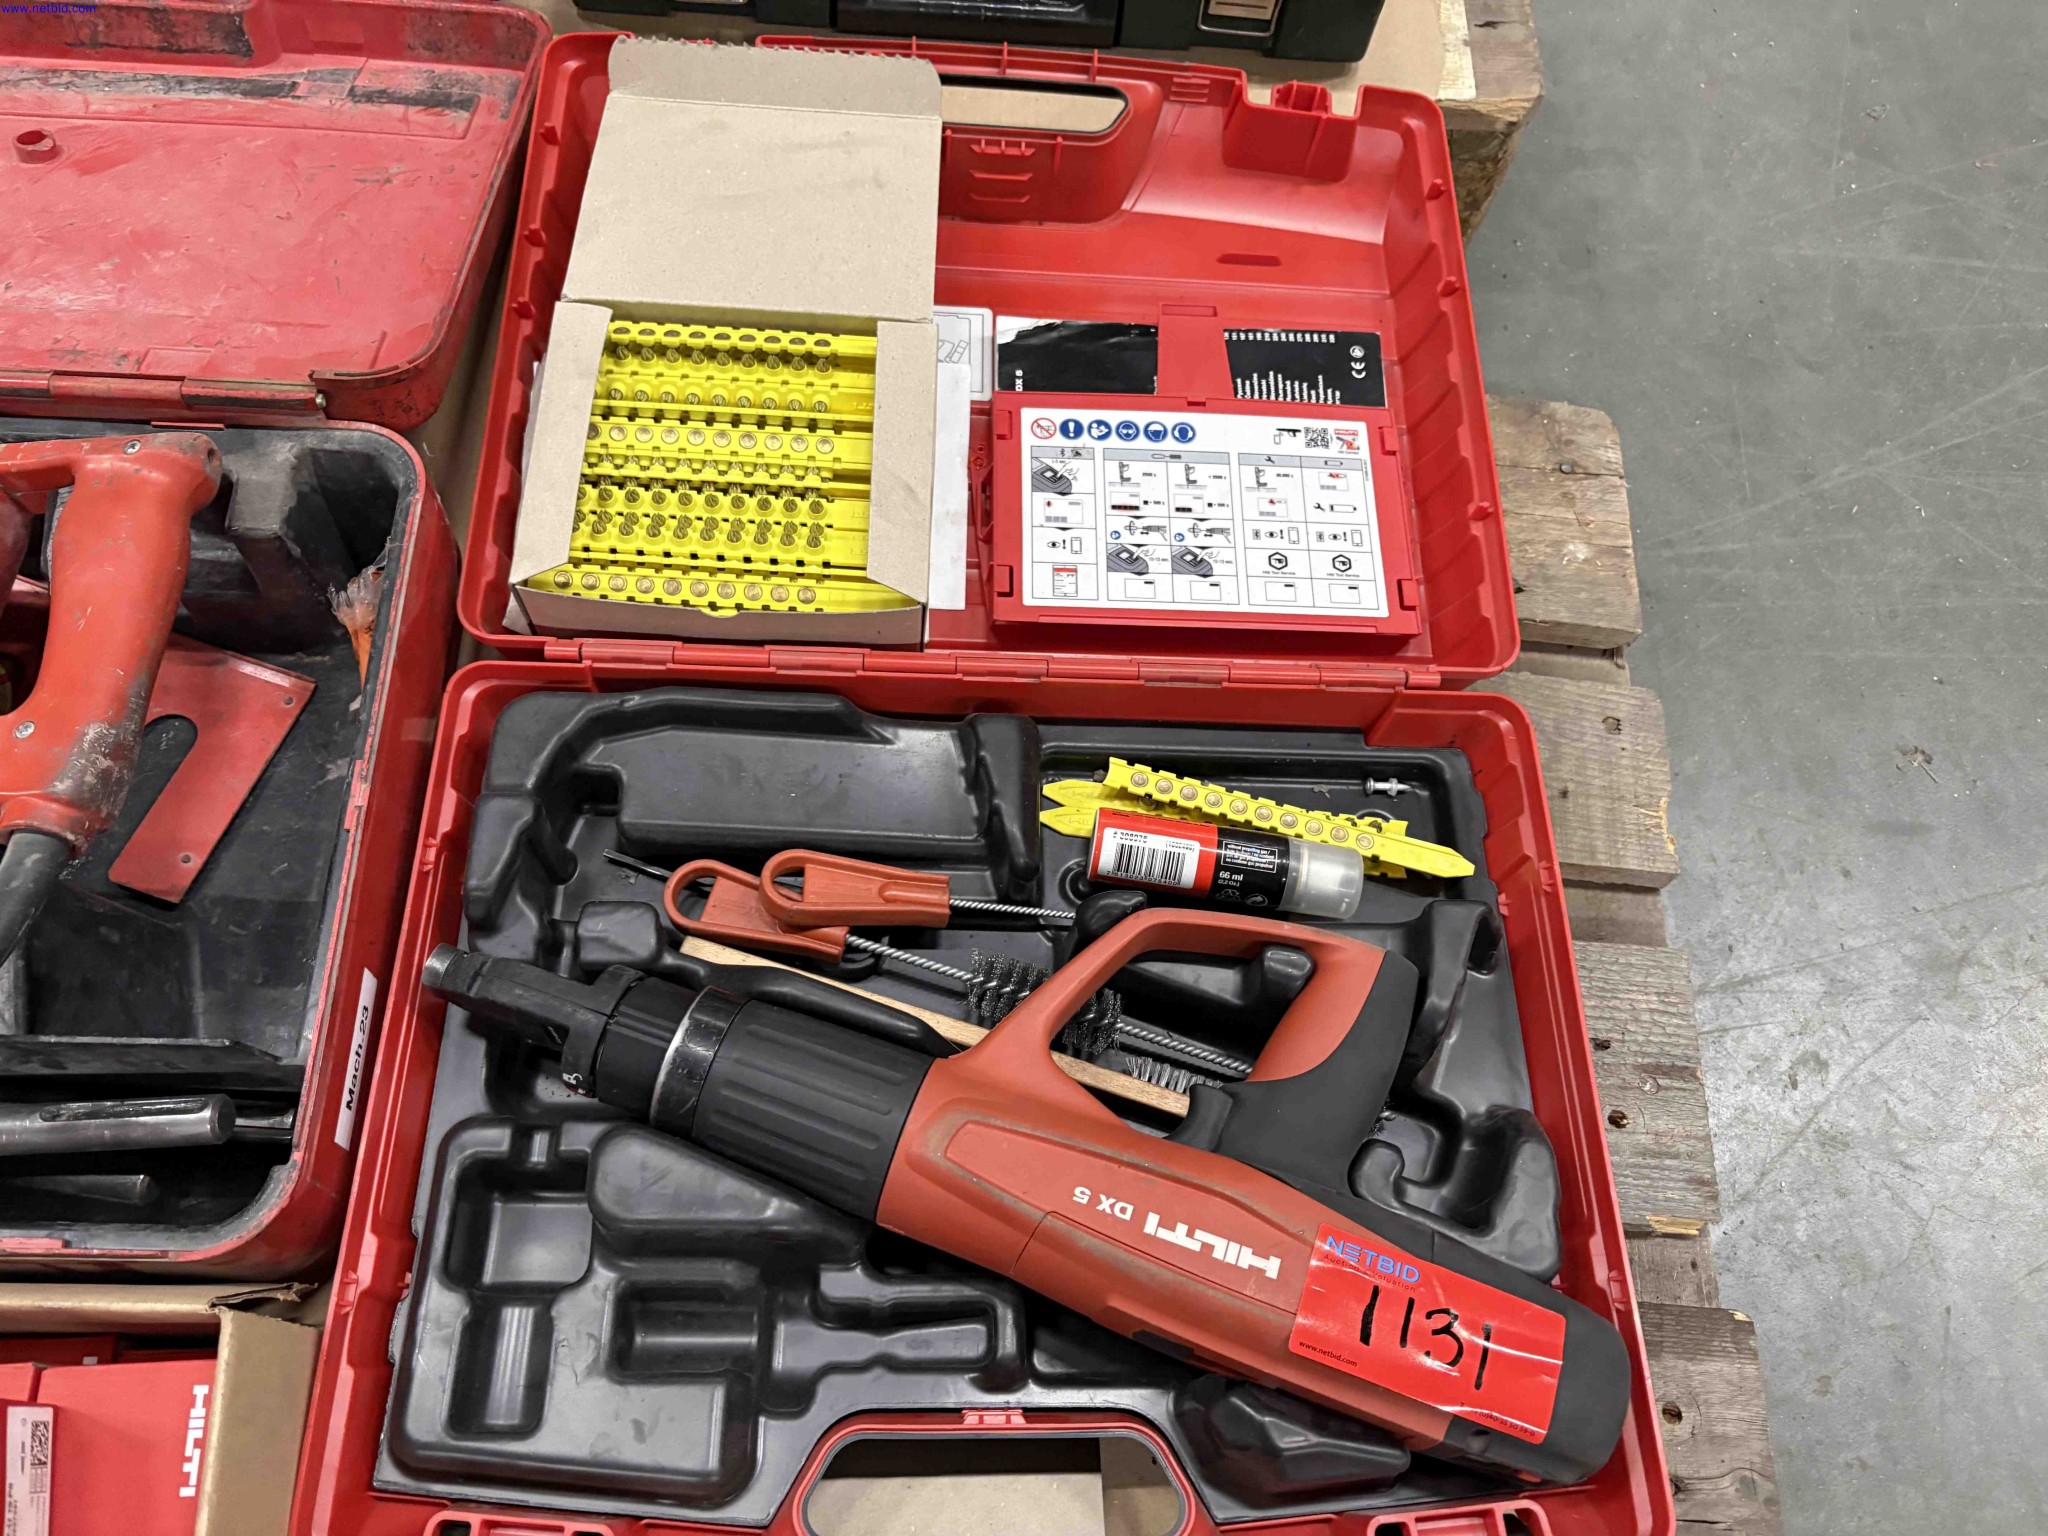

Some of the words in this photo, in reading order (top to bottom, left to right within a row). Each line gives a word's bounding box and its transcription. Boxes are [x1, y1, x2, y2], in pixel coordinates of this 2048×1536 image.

[1219, 870, 1231, 879] 66
[1232, 873, 1243, 881] ml
[1072, 1186, 1091, 1205] 5
[1096, 1193, 1134, 1221] DX
[1143, 1212, 1281, 1280] HILTI
[1326, 1236, 1421, 1282] NETBID
[1323, 1254, 1360, 1272] Auction
[1360, 1284, 1494, 1390] 1131
[1299, 1341, 1358, 1367] www.netbid.com
[179, 1384, 209, 1498] HILTI
